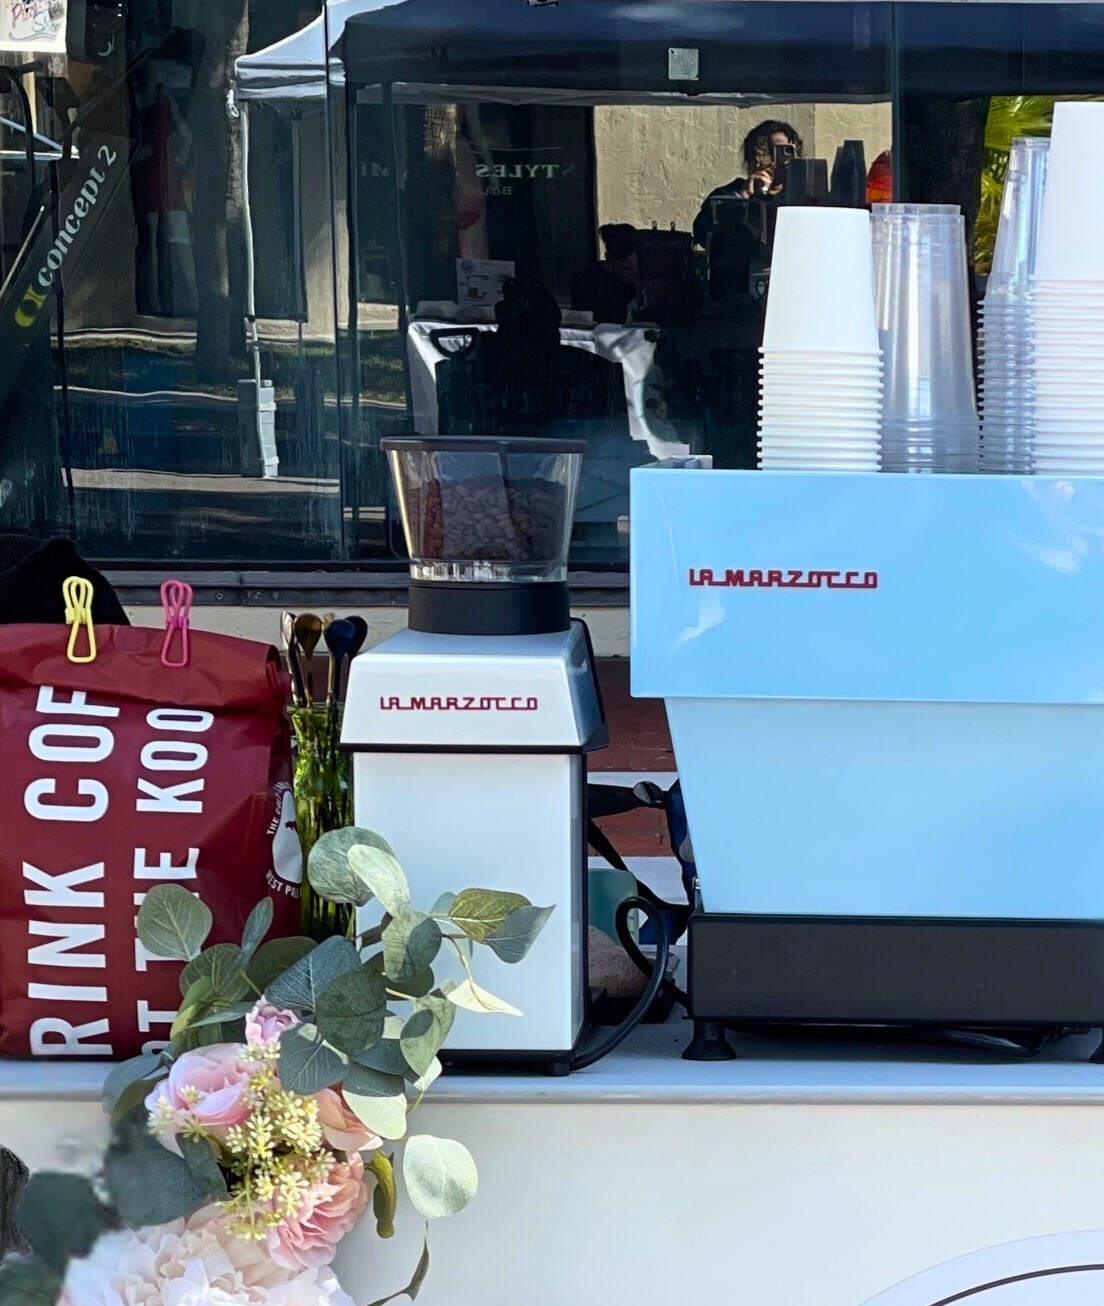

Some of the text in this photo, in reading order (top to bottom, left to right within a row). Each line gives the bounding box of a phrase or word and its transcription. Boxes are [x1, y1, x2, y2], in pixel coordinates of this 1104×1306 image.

[38, 144, 117, 288] concept 2
[689, 568, 713, 586] LA
[380, 696, 400, 710] LA
[133, 847, 200, 972] TE
